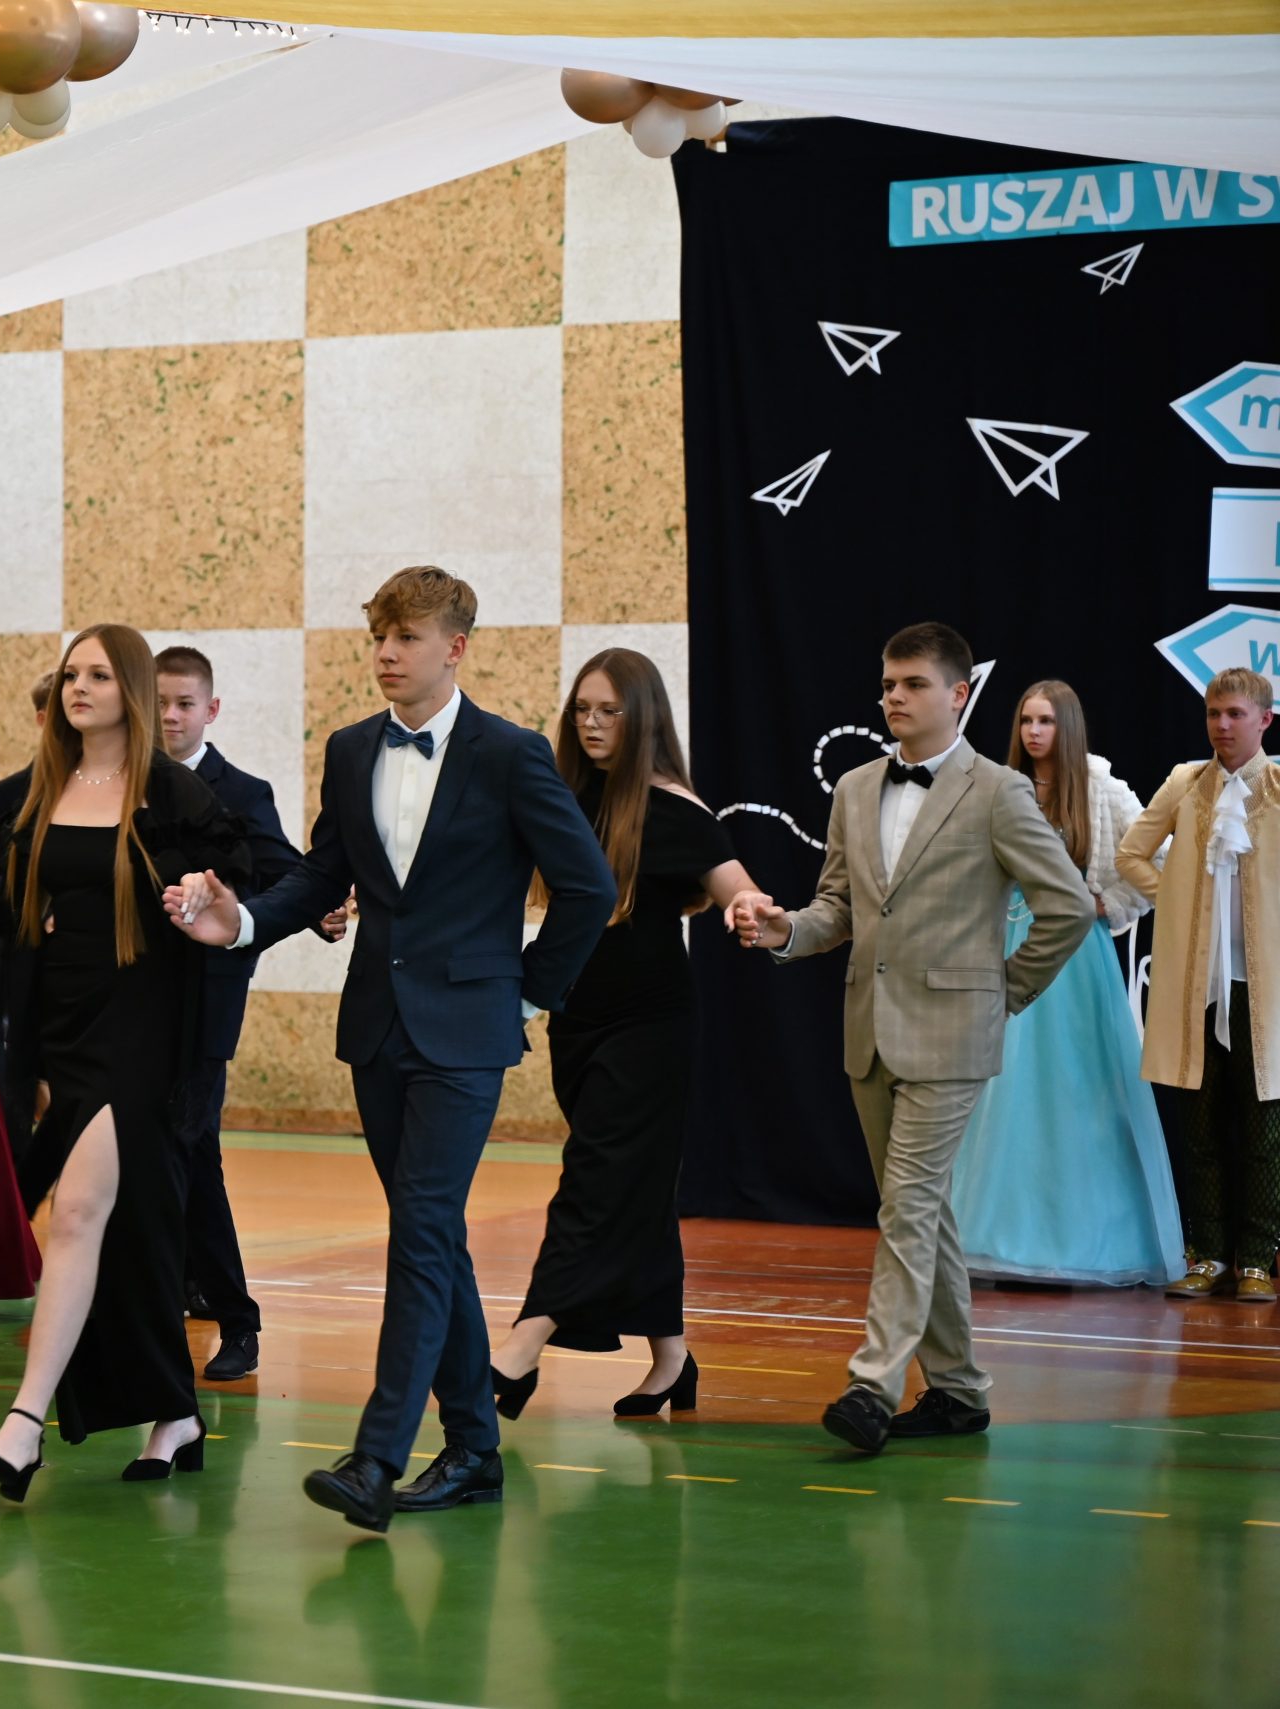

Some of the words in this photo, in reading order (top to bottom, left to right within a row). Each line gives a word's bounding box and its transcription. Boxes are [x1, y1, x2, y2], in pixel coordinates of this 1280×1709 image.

[911, 171, 1135, 238] RUSZAJ
[1153, 168, 1220, 221] W
[1238, 173, 1280, 218] S
